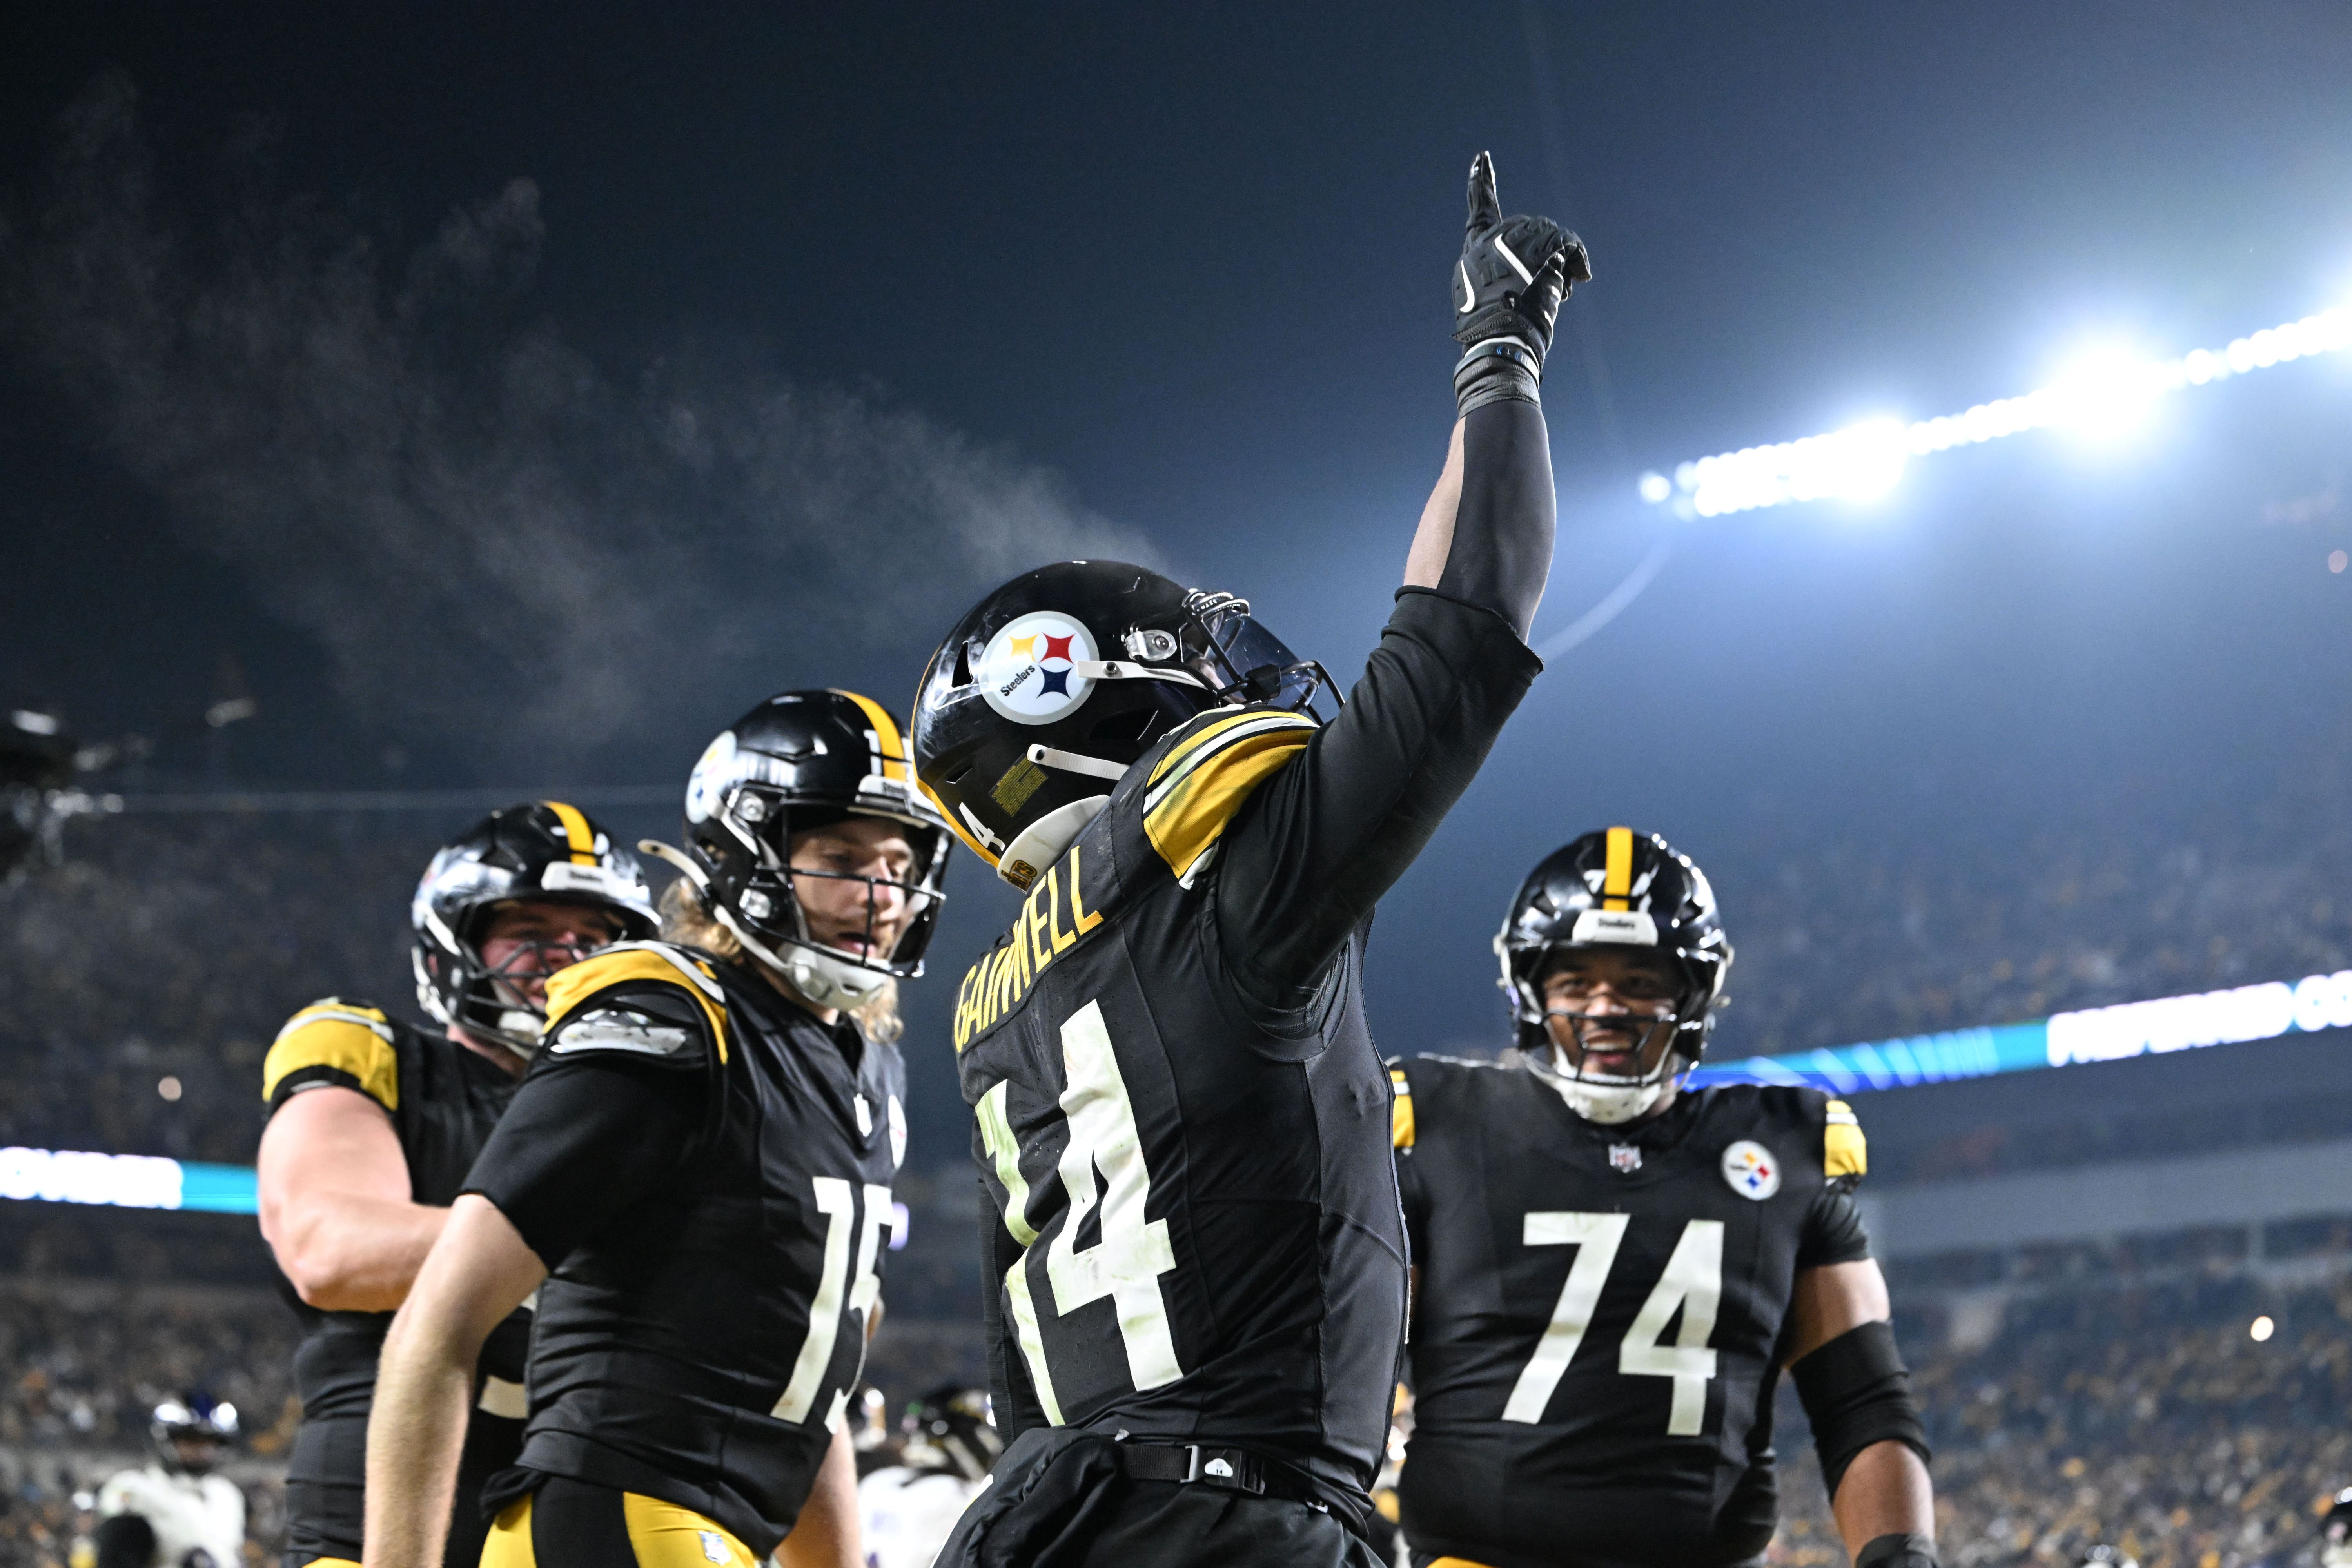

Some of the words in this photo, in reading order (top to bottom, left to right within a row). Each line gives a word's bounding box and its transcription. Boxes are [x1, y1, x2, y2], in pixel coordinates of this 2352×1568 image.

[1000, 665, 1035, 696] Steelers
[959, 802, 1005, 851] 4
[975, 998, 1184, 1427] 14
[1501, 1212, 1724, 1436] 74
